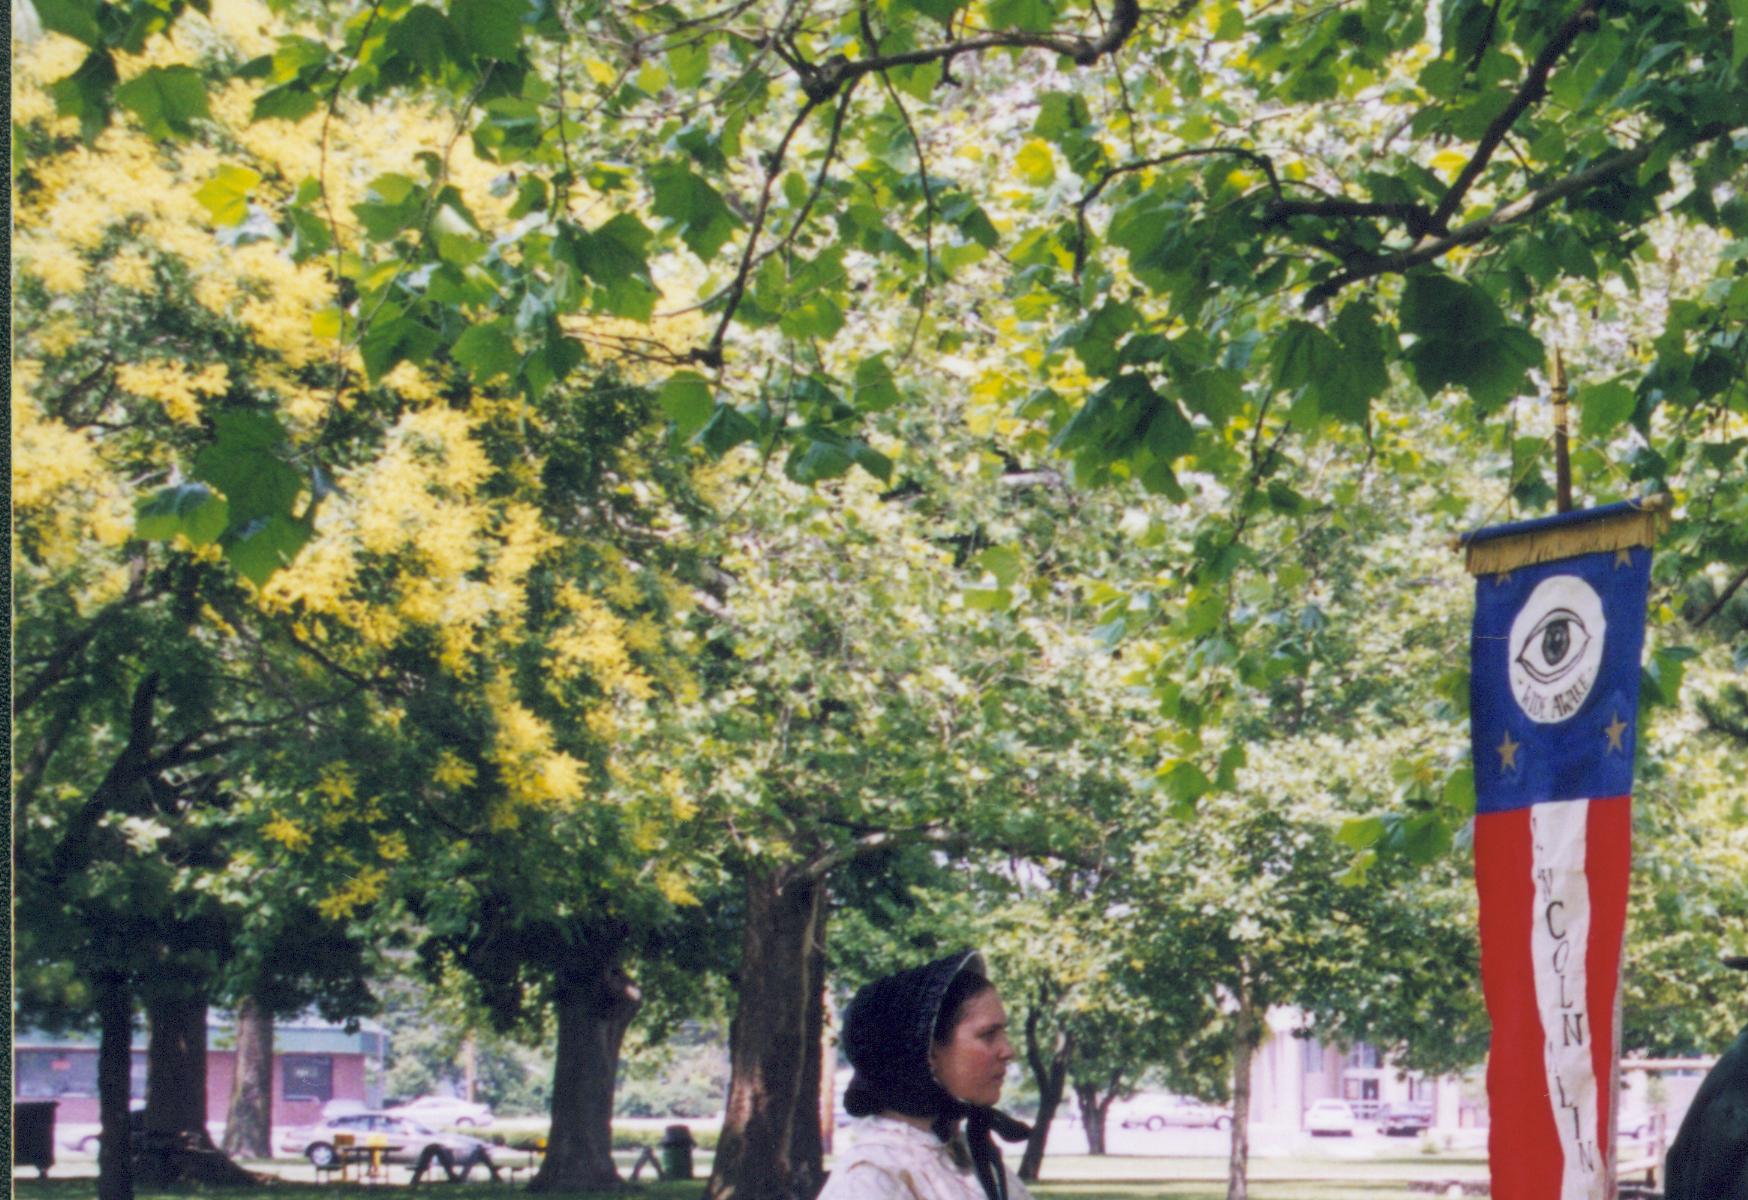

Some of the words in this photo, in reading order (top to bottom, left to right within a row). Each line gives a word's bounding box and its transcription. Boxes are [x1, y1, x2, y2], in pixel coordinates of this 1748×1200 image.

[1522, 684, 1548, 719] WIDE
[1551, 673, 1588, 718] AWAKE
[1532, 817, 1583, 1047] NCOLN
